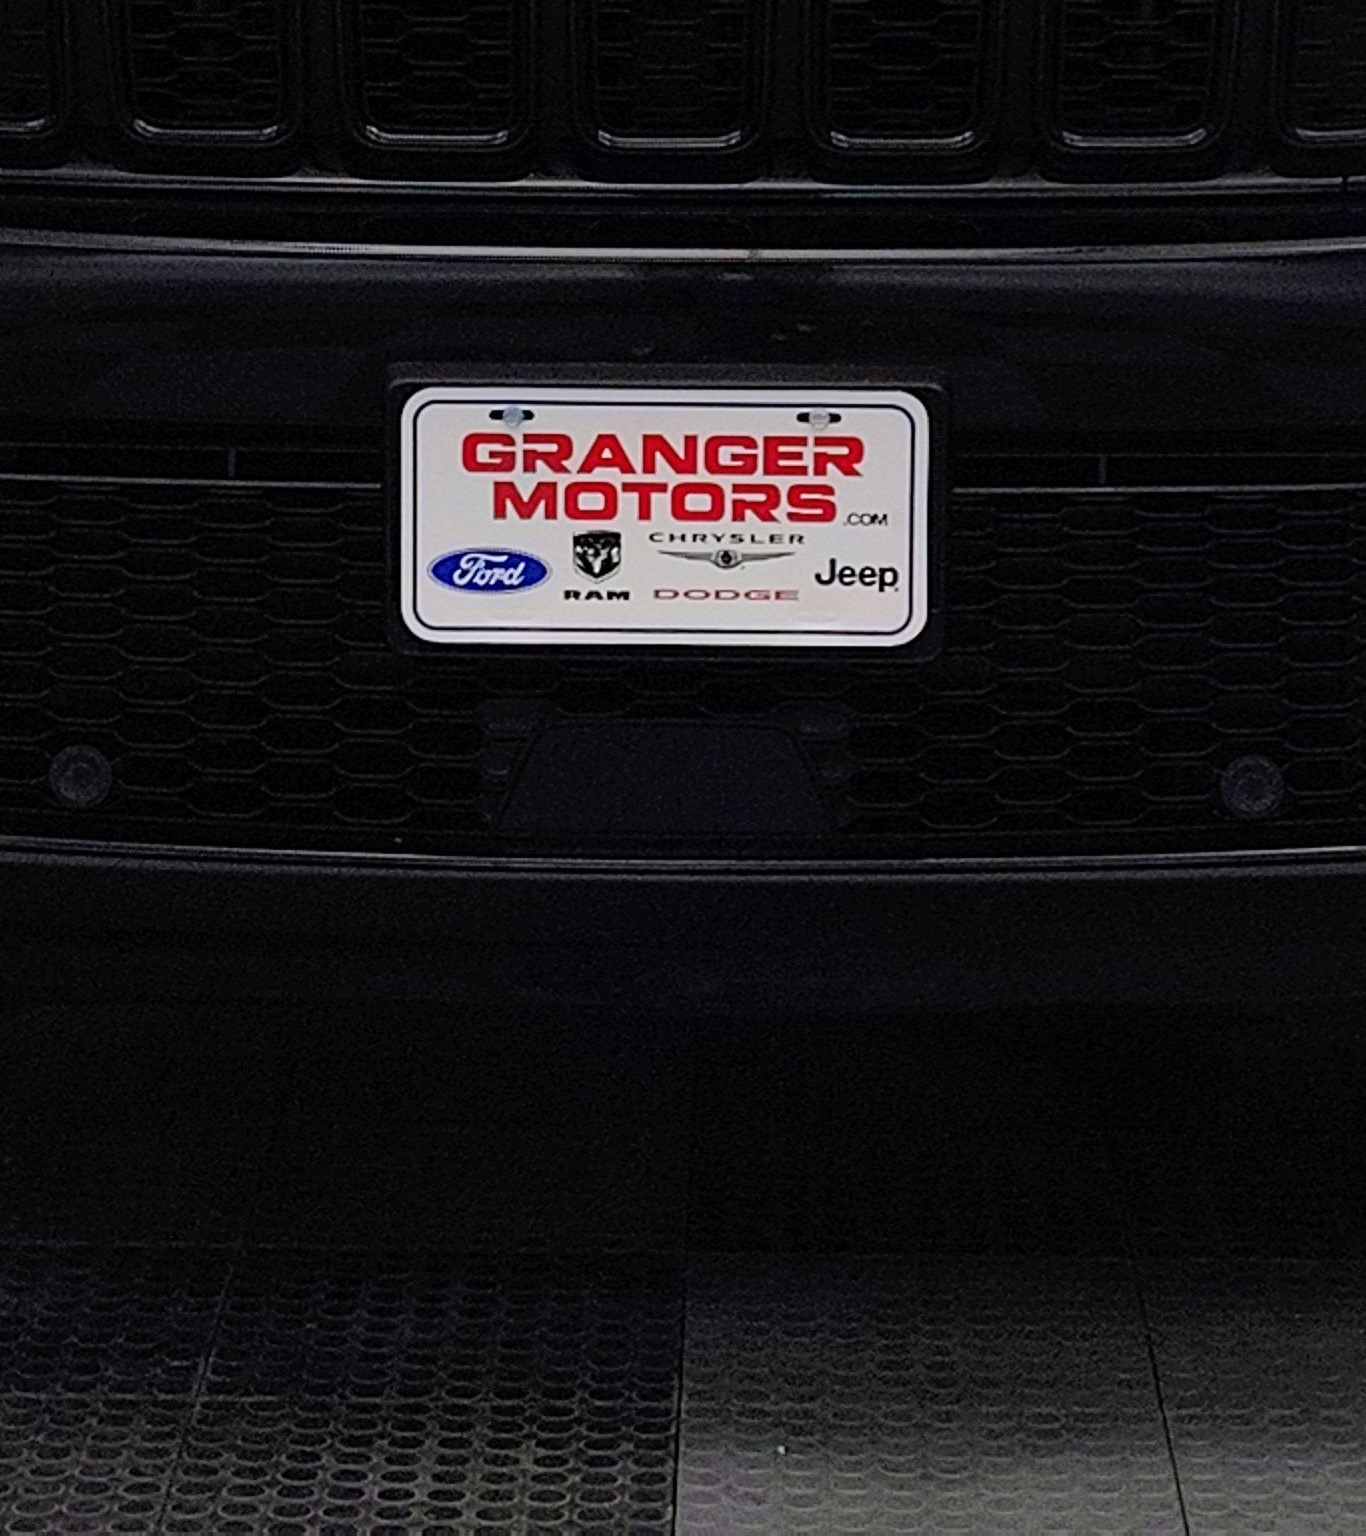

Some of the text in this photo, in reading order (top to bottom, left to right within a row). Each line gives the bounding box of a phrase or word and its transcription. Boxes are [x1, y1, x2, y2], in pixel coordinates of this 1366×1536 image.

[462, 432, 865, 477] GRANGER
[493, 480, 889, 527] MOTORS .COM
[648, 531, 805, 545] CHRYSLER
[453, 553, 525, 586] Ford
[815, 558, 899, 592] Jeep
[563, 589, 630, 601] RAM
[653, 589, 800, 602] DODGE
